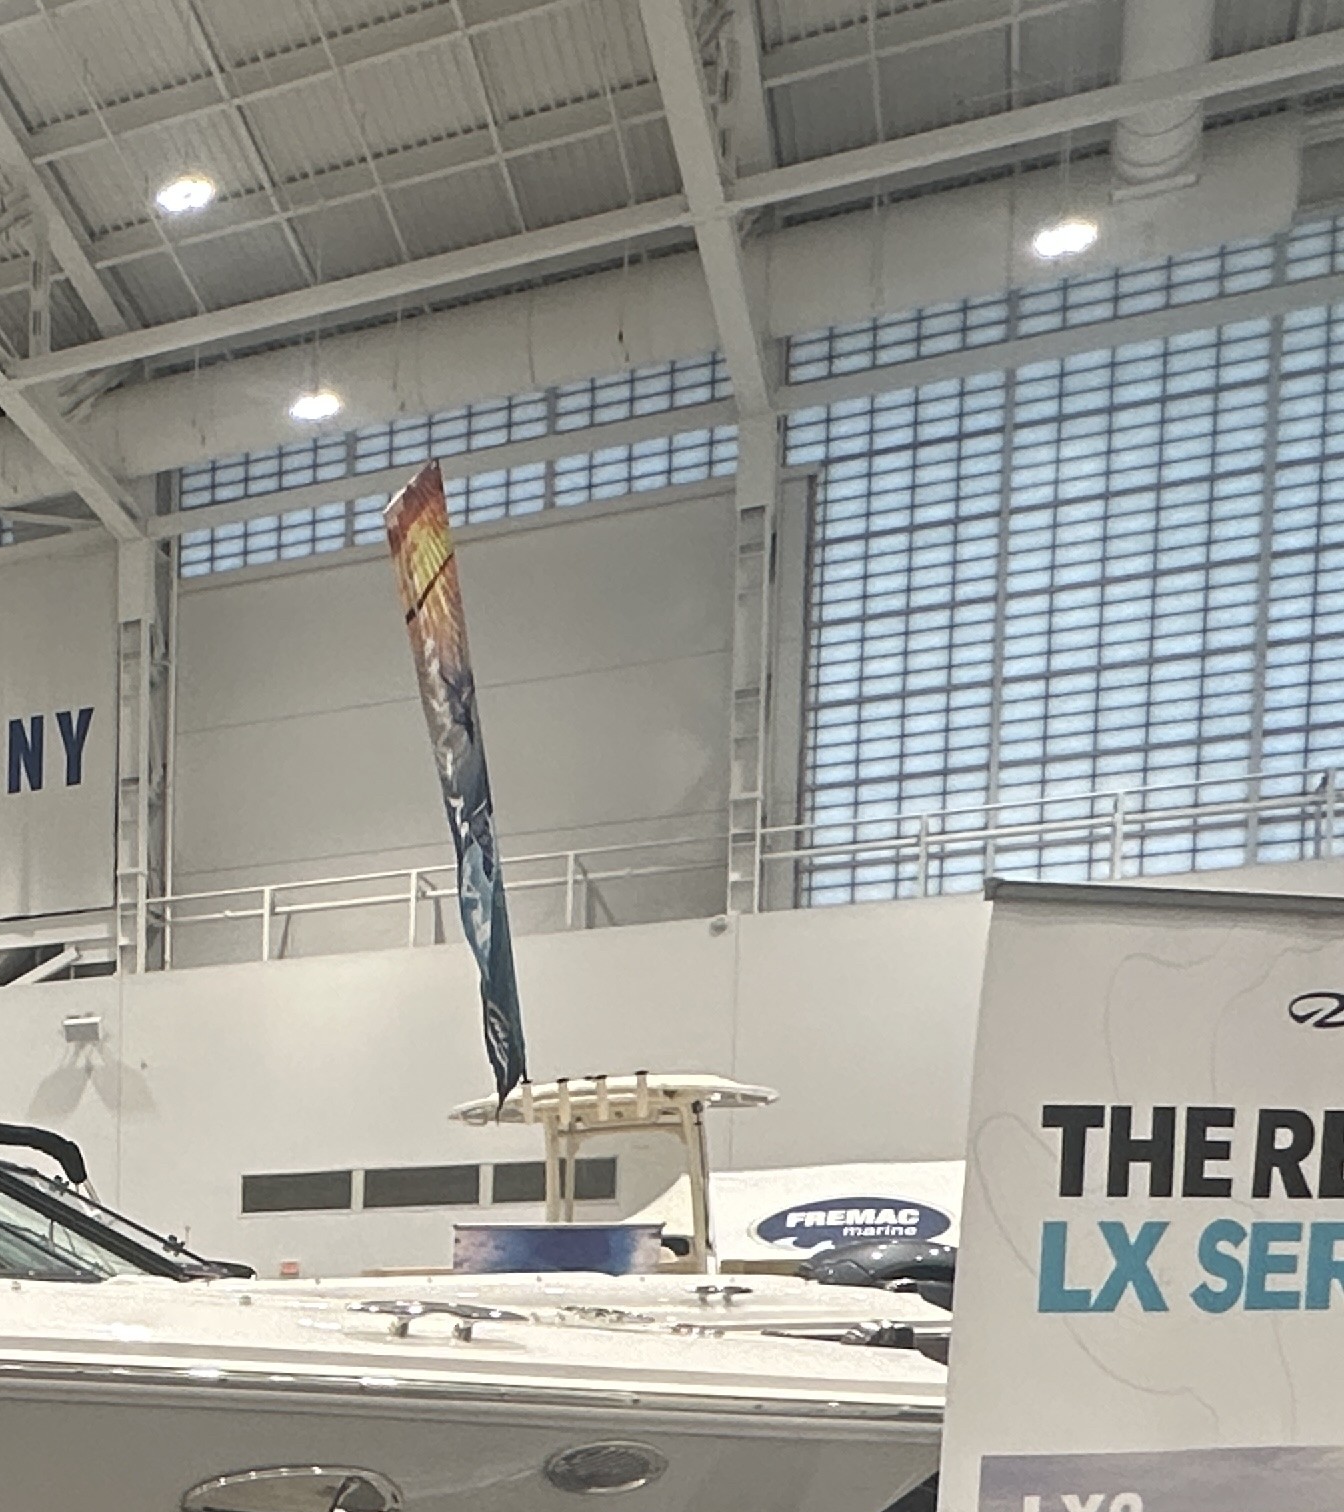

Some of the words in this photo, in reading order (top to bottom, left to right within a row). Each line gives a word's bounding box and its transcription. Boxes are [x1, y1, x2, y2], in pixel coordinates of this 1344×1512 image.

[7, 707, 95, 794] NY
[1042, 1104, 1236, 1198] THE
[785, 1208, 920, 1228] FREMAC
[842, 1224, 918, 1237] marine
[1038, 1220, 1171, 1313] LX
